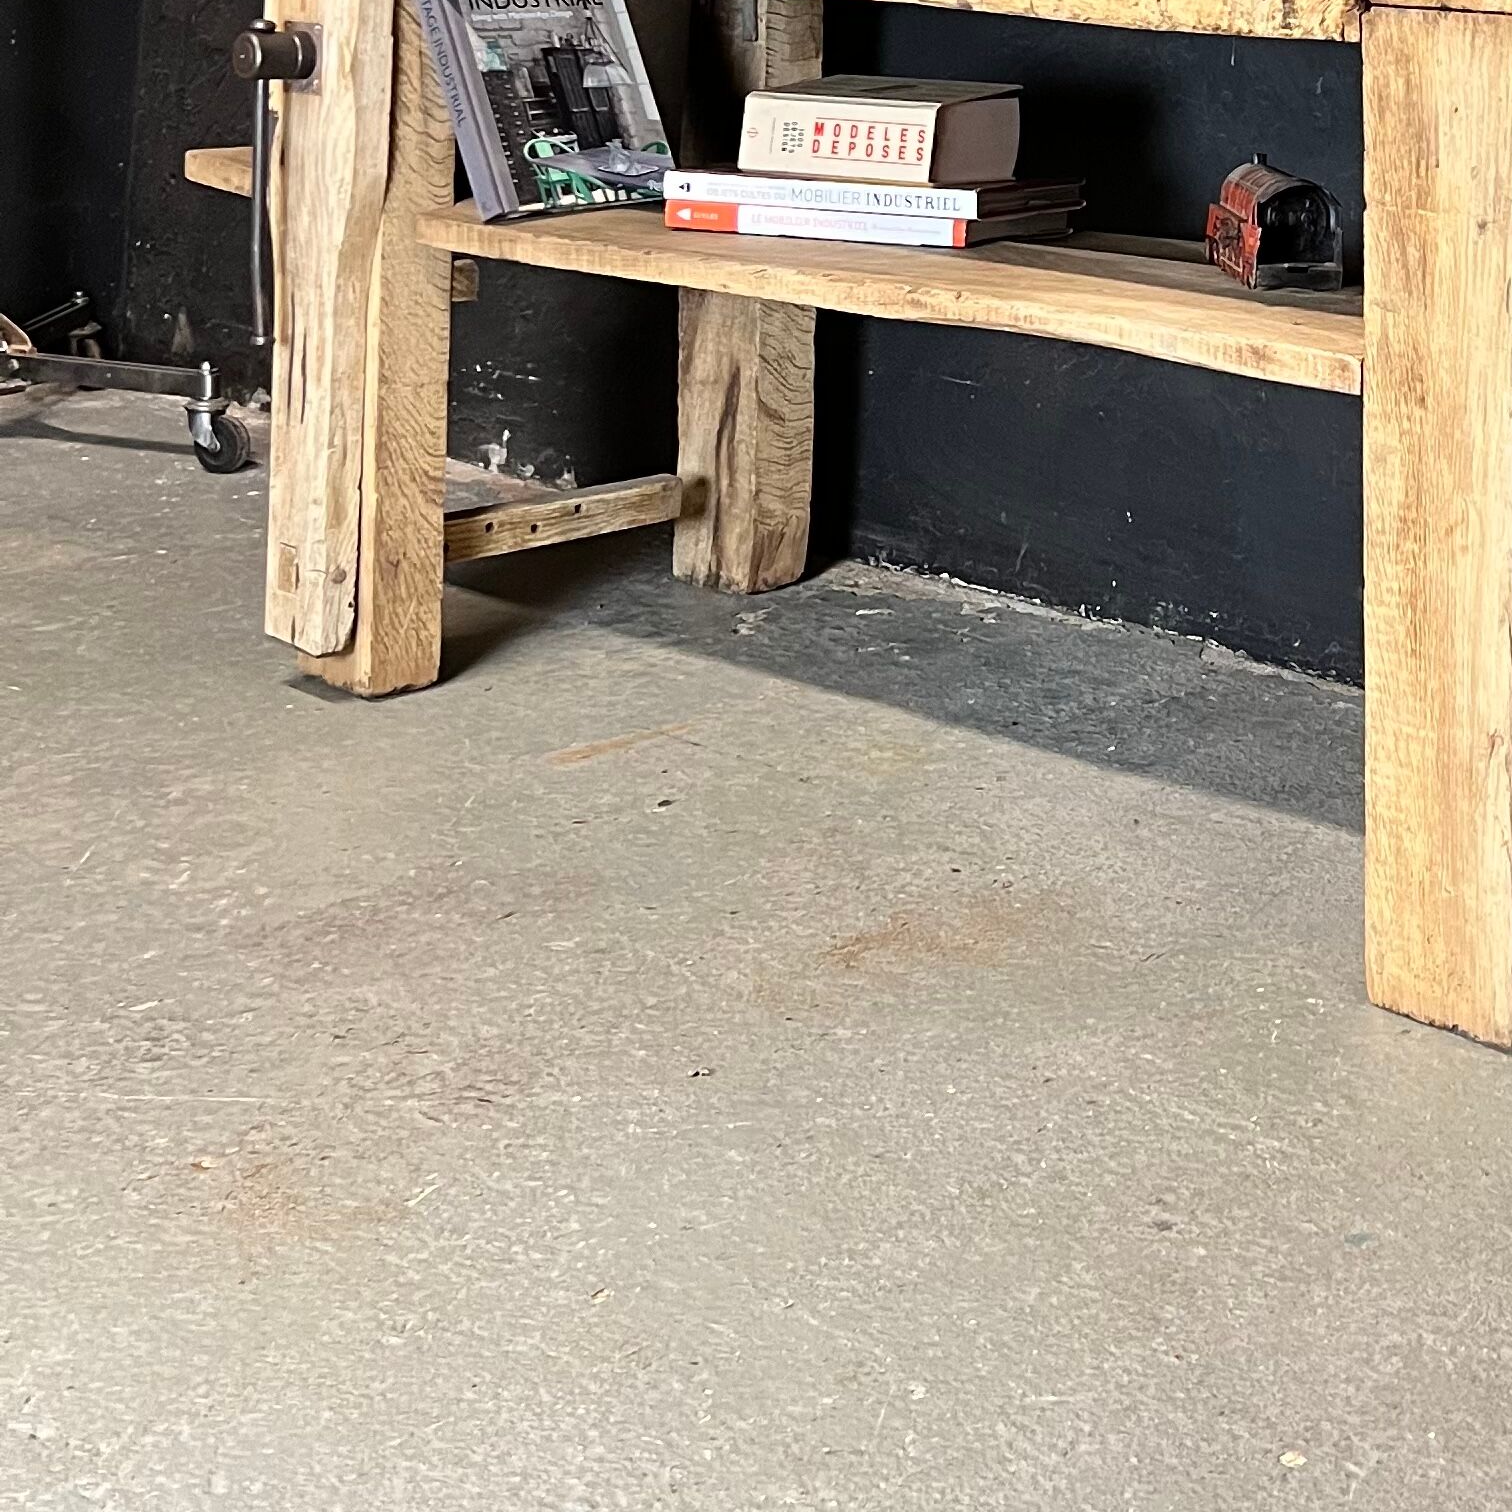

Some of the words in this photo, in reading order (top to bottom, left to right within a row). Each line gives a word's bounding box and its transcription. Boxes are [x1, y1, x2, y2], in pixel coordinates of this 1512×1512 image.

[433, 39, 467, 128] INDUSTRIAL
[813, 121, 926, 144] MODELES
[812, 139, 924, 162] DEPOSES
[791, 188, 862, 206] MOBILIER
[866, 192, 962, 212] INDUSTRIEL
